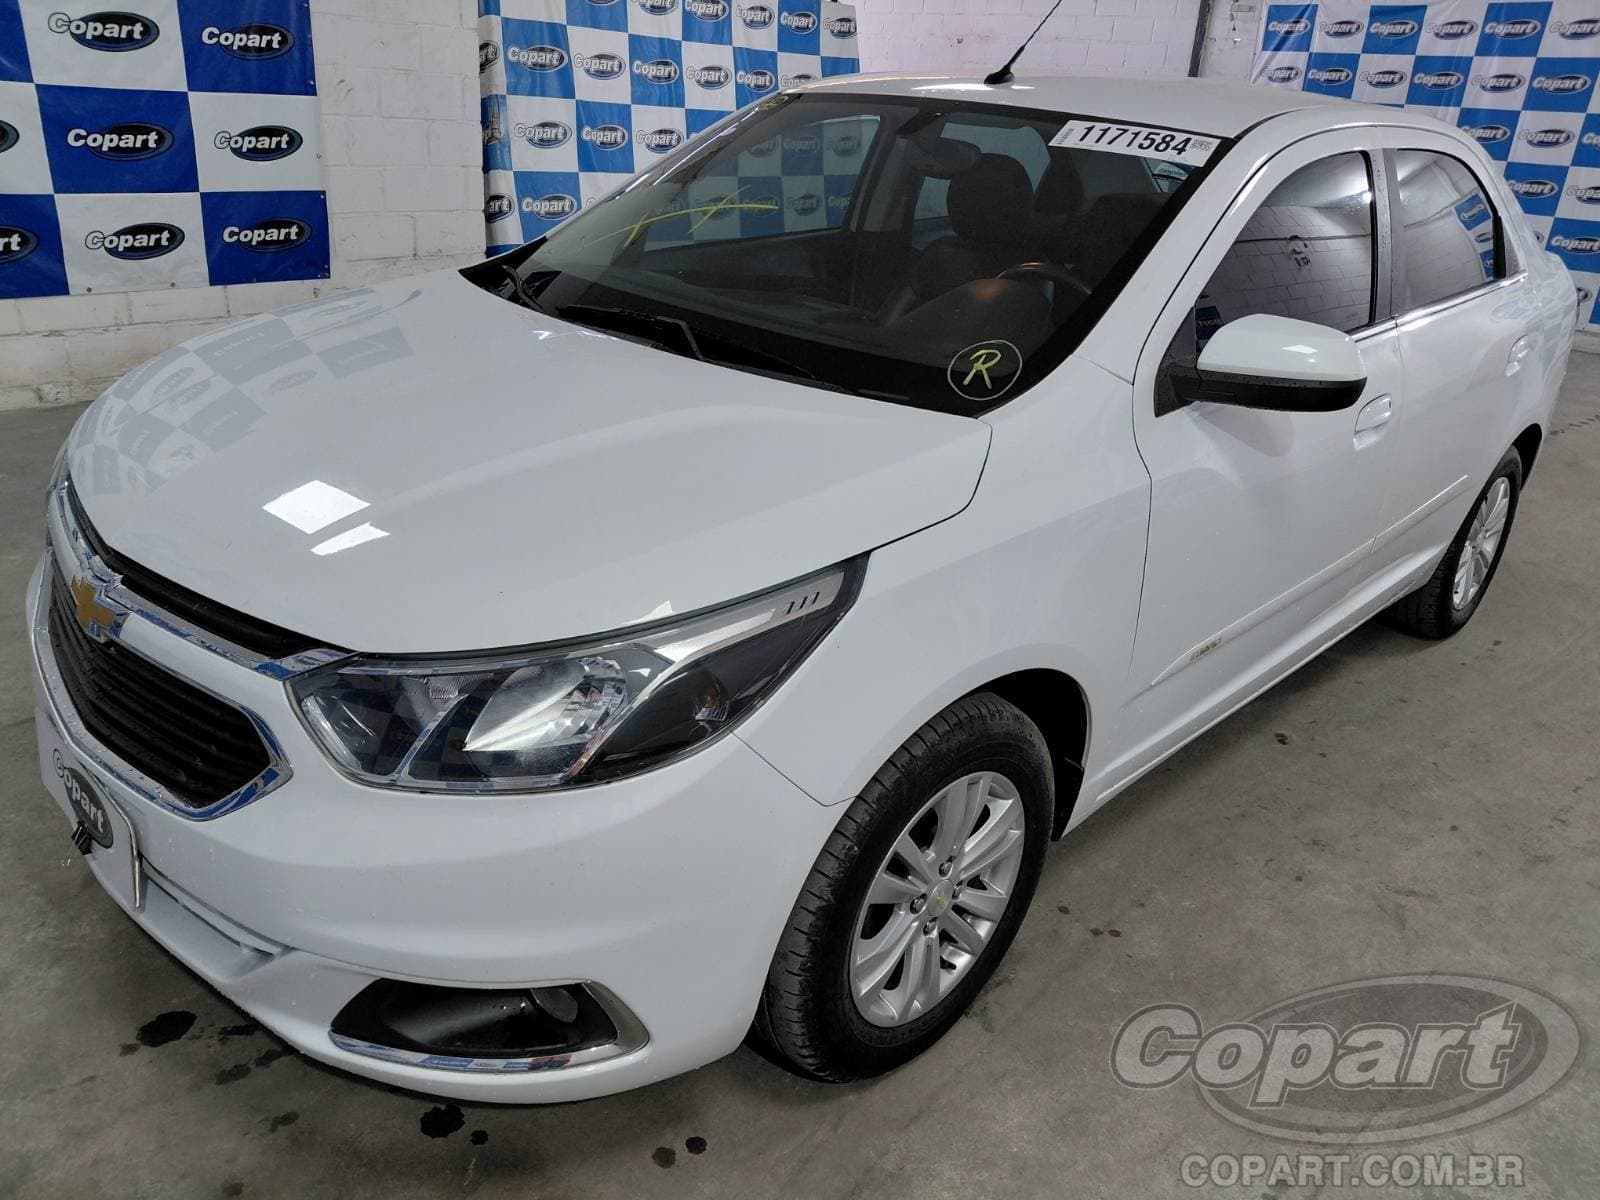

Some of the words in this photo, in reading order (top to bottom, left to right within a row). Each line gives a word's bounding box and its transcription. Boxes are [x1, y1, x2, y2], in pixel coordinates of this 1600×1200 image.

[685, 0, 723, 16] Copart
[736, 5, 770, 23] Copart
[48, 12, 144, 39] Copart
[781, 12, 813, 29] Copart
[823, 18, 856, 34] Copart
[1268, 21, 1305, 33] Copart
[1320, 21, 1358, 34] Copart
[1370, 22, 1411, 34] Copart
[1425, 22, 1470, 35] Copart
[1485, 22, 1534, 36] Copart
[202, 26, 281, 49] Copart
[507, 46, 561, 66] Copart
[574, 53, 619, 73] Copart
[633, 60, 675, 79] Copart
[686, 65, 726, 84] Copart
[736, 70, 770, 87] Copart
[1308, 69, 1347, 81] Copart
[1359, 71, 1401, 84] Copart
[1414, 72, 1458, 86] Copart
[1471, 75, 1519, 88] Copart
[1533, 76, 1584, 91] Copart
[67, 128, 158, 150] Copart
[514, 122, 565, 140] Copart
[582, 126, 623, 144] Copart
[635, 129, 678, 146] Copart
[1079, 125, 1192, 155] 1171584
[1518, 129, 1568, 144] Copart
[214, 130, 289, 151] Copart
[522, 196, 571, 215] Copart
[85, 230, 170, 251] Copart
[222, 225, 298, 245] Copart
[963, 349, 1001, 389] R
[53, 749, 104, 833] Copart
